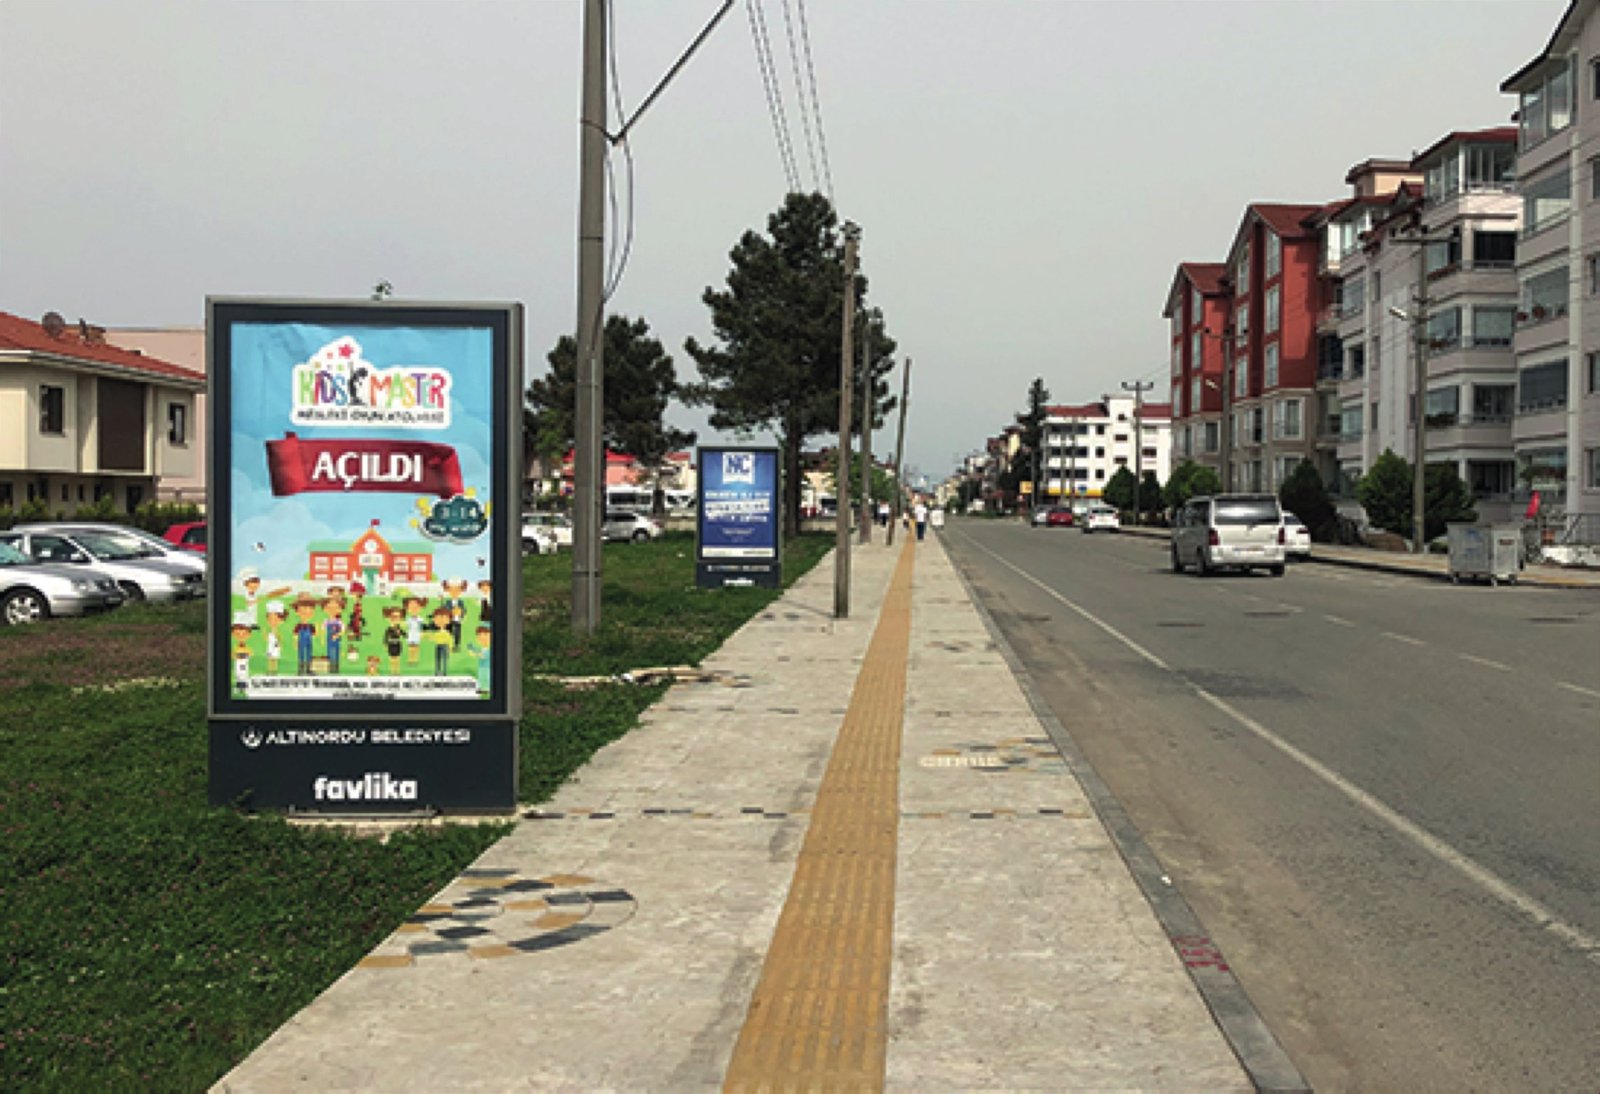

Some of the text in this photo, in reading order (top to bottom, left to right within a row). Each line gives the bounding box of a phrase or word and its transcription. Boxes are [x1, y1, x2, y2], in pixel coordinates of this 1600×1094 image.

[370, 373, 447, 408] MASTER
[312, 451, 422, 487] AÇILDI
[266, 729, 365, 744] ALTINORDU
[314, 772, 418, 800] favlika
